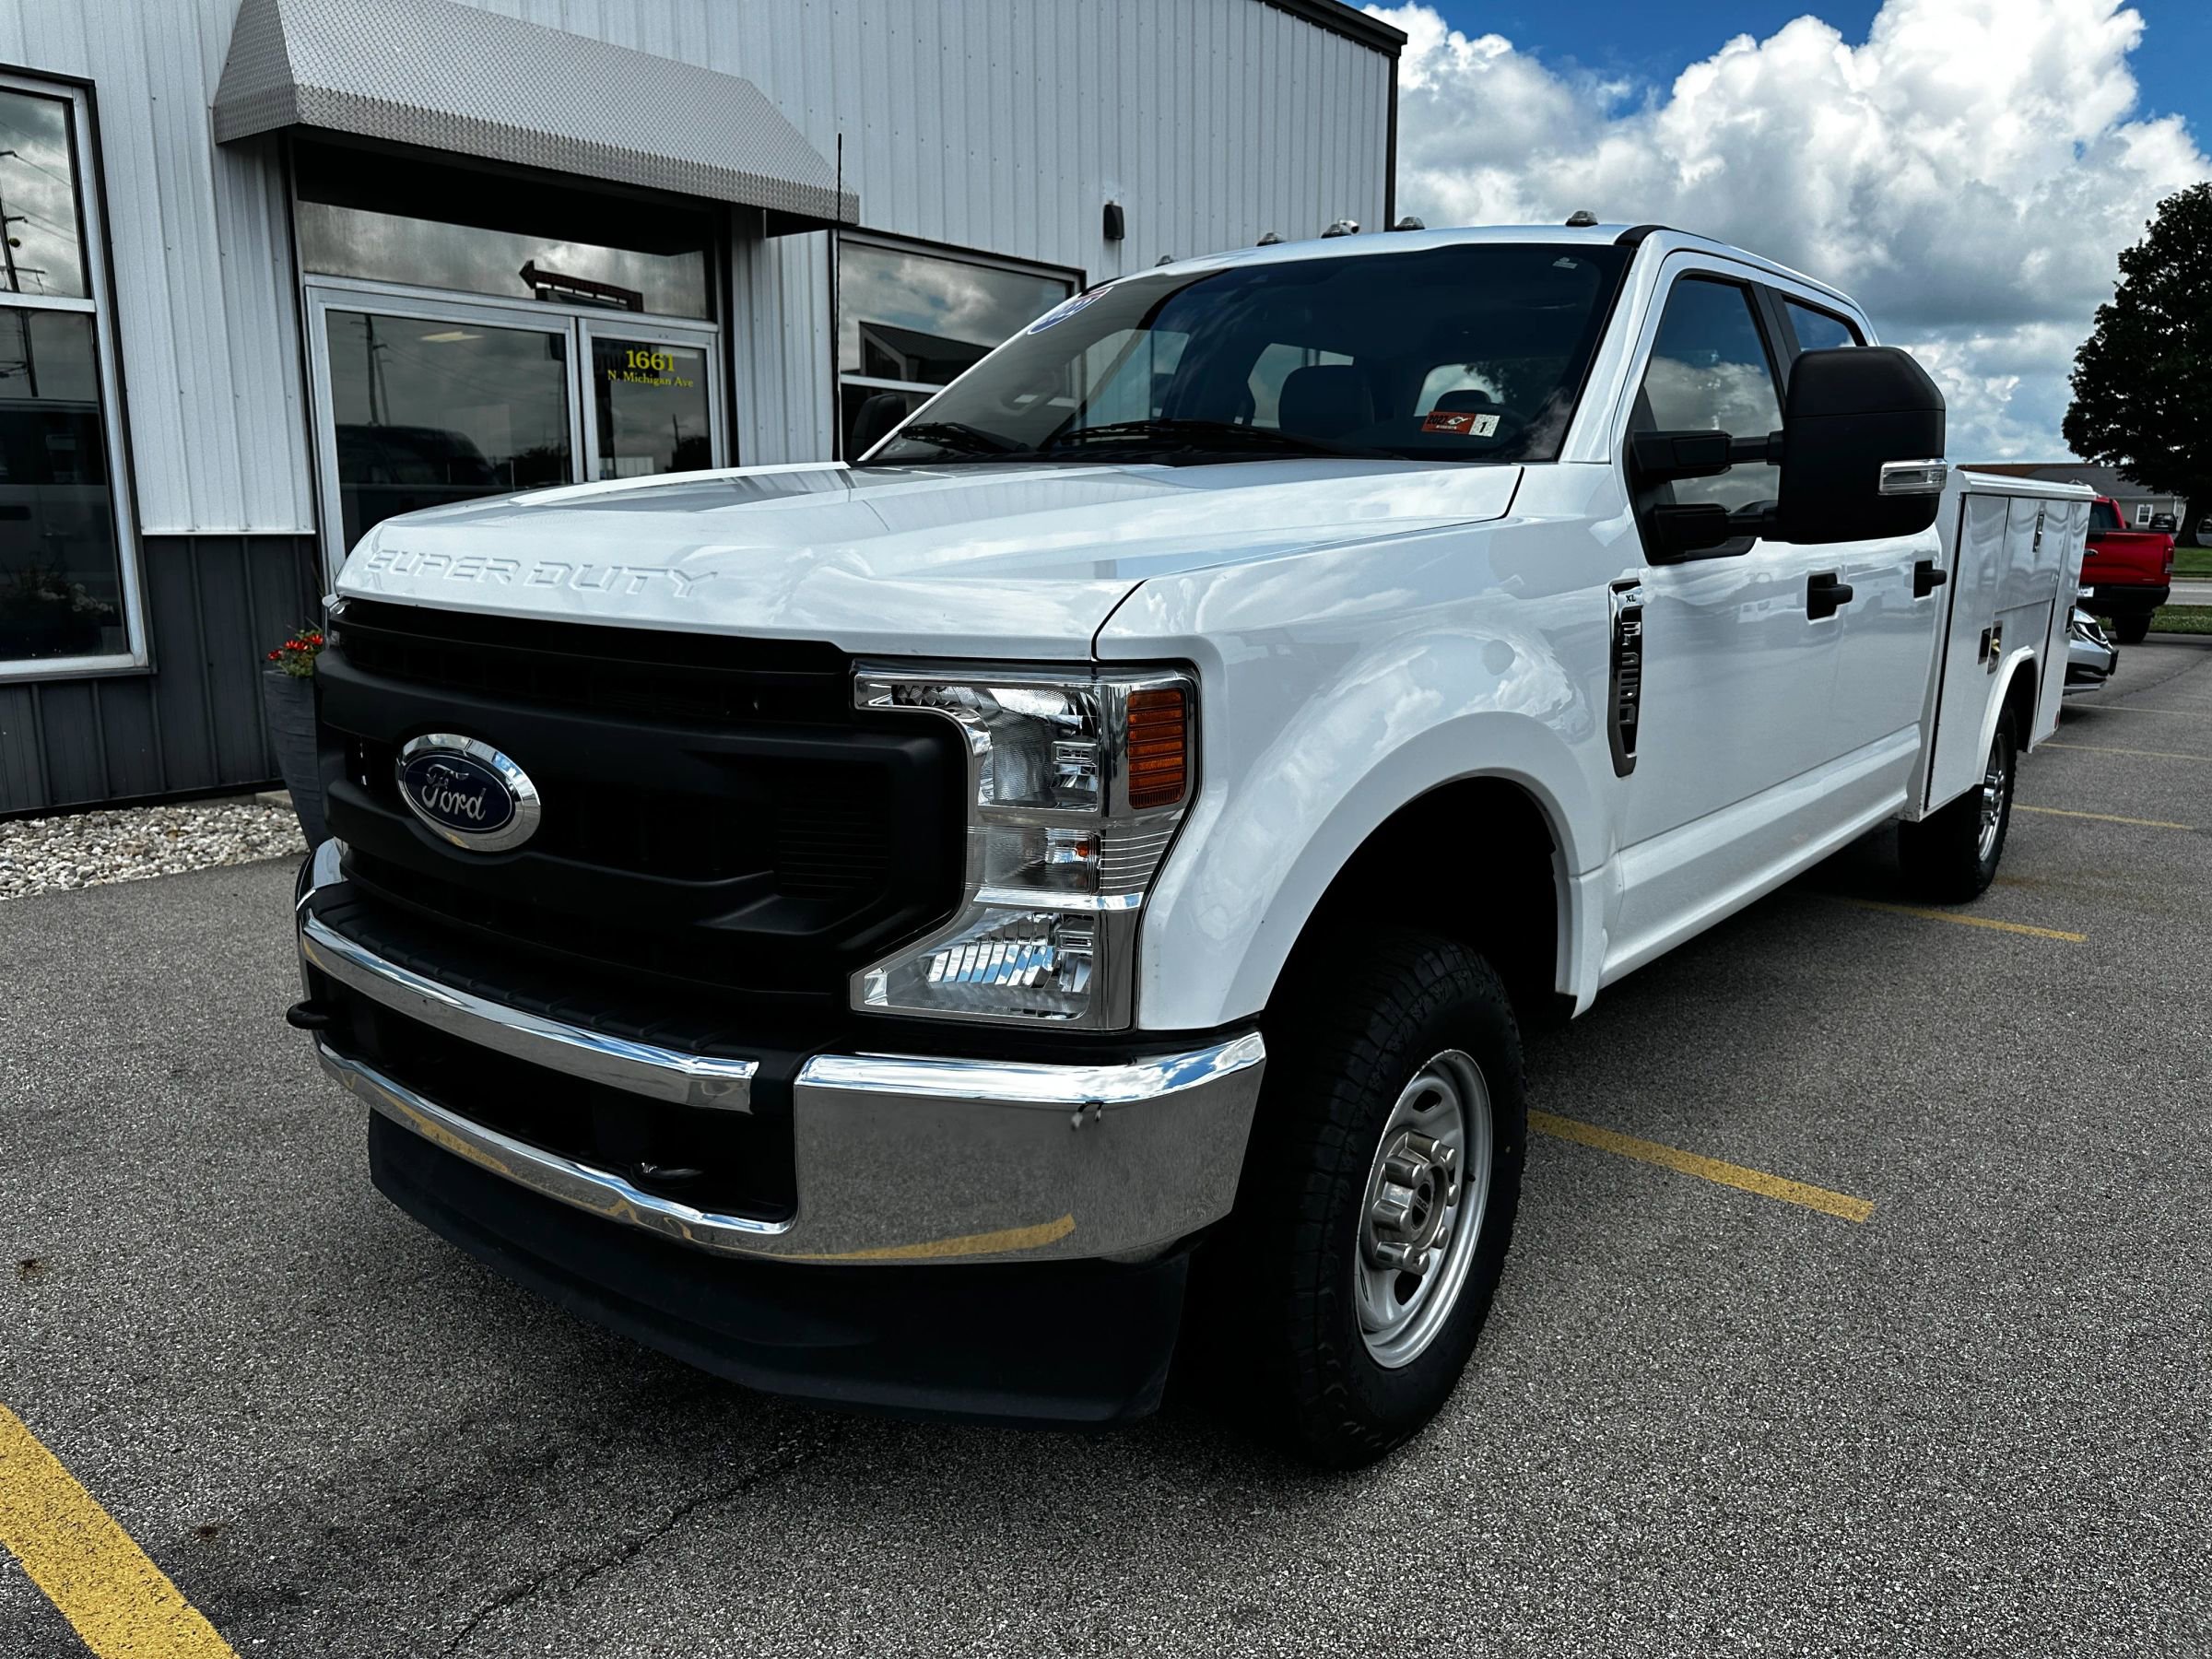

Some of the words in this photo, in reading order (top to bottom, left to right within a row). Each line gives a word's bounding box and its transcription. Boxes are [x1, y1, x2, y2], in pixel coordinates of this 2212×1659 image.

[626, 350, 676, 372] 1661
[607, 370, 620, 382] N.
[623, 371, 672, 387] Michigan
[674, 376, 694, 388] Ave
[1479, 421, 1488, 433] 1
[363, 548, 522, 585] SUPER
[524, 559, 719, 598] DUTY
[1625, 594, 1637, 603] XL
[421, 763, 487, 821] Ford
